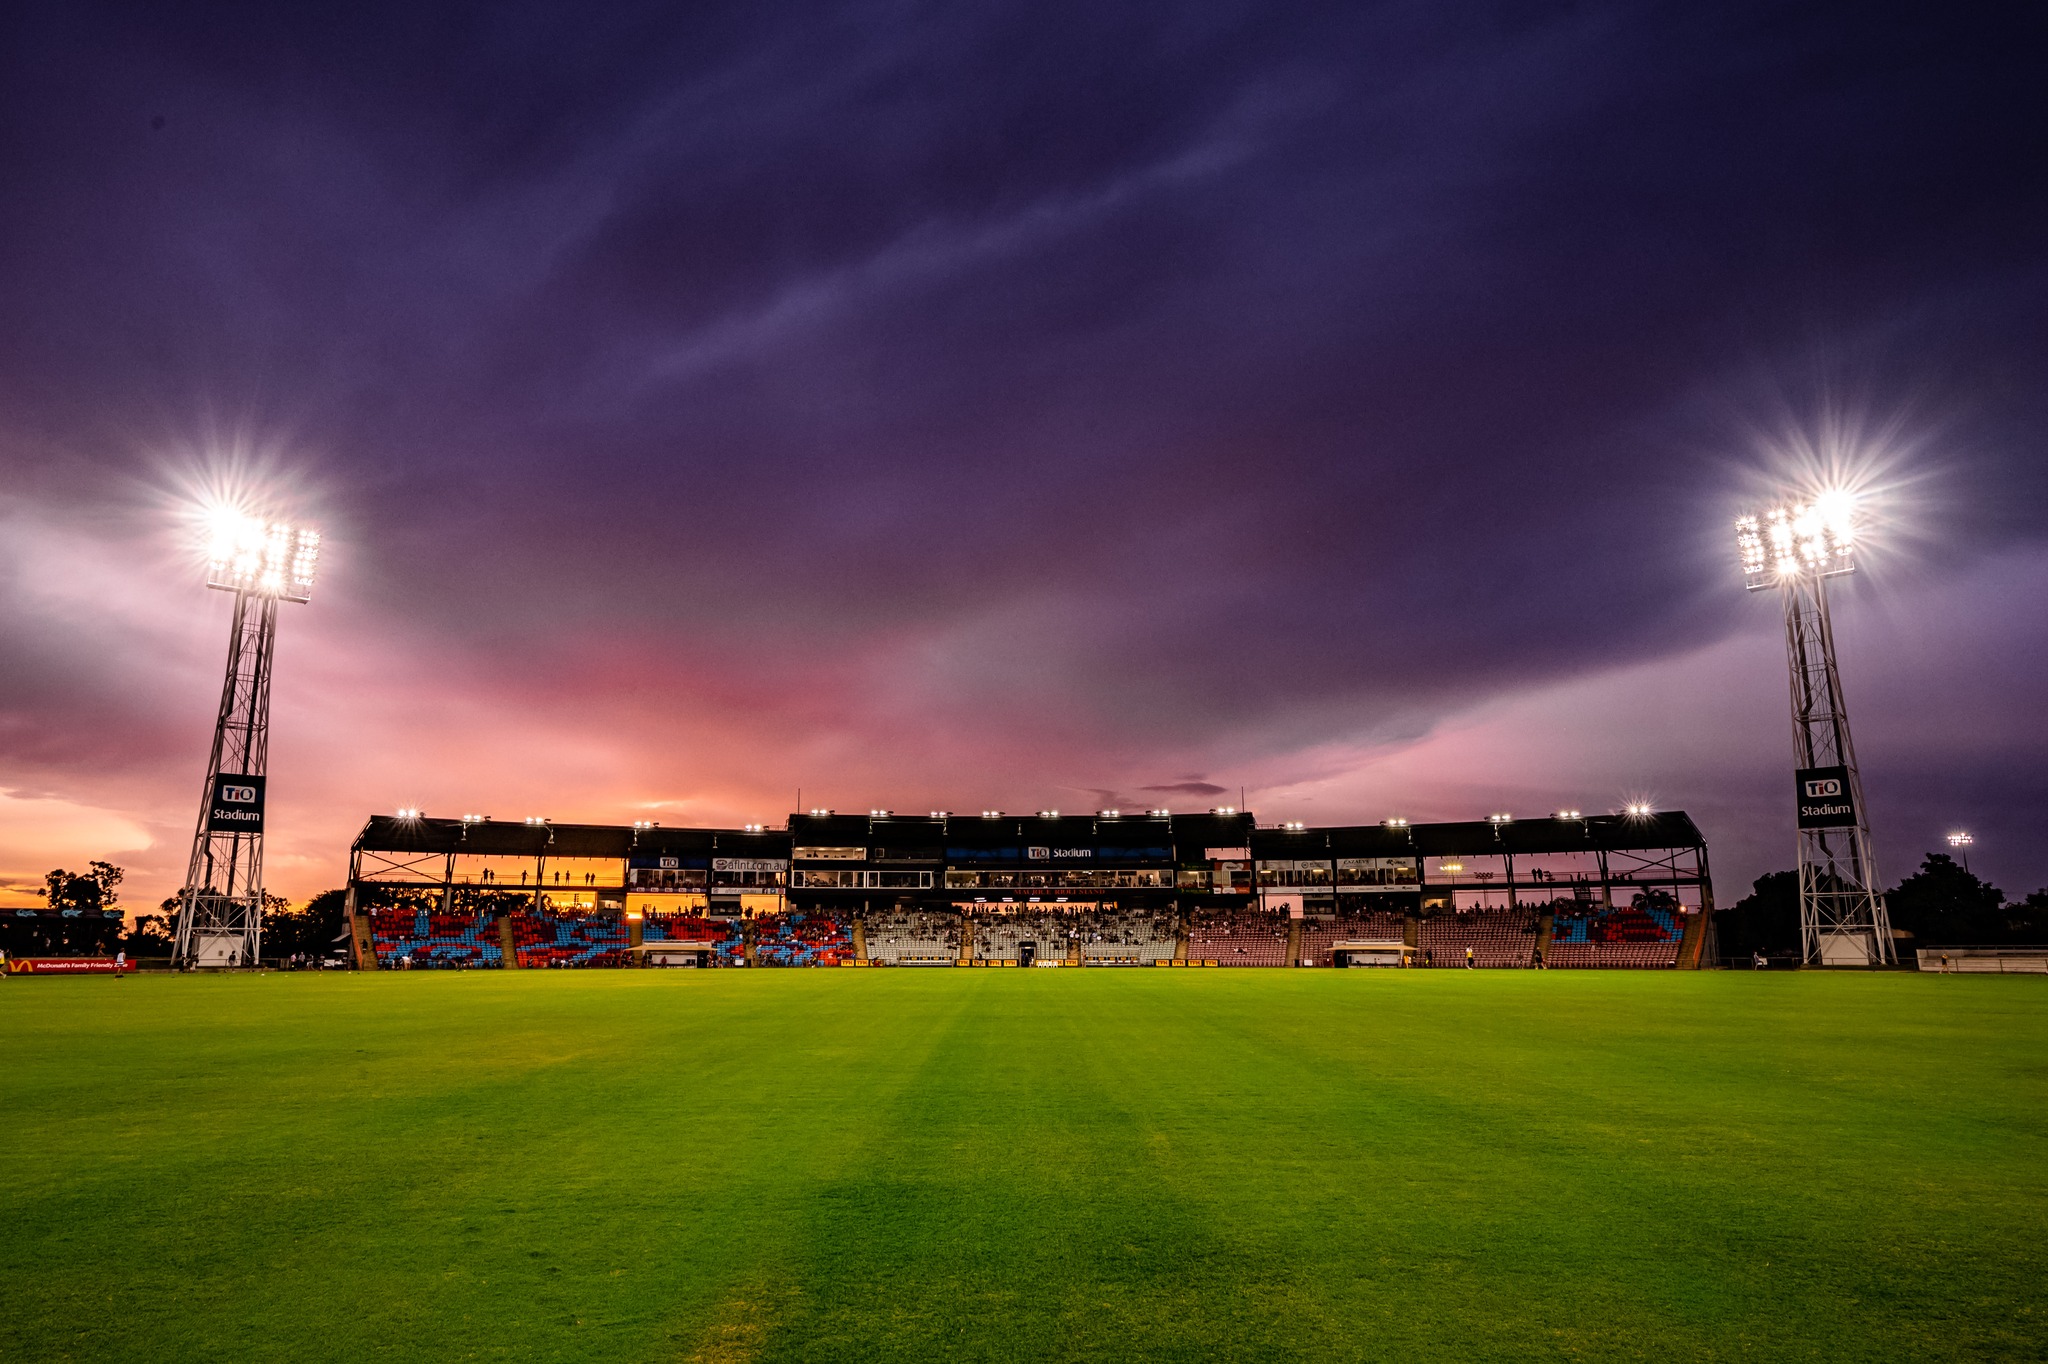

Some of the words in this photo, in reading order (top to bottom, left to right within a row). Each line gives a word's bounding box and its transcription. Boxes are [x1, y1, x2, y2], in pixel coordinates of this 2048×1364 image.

[213, 808, 260, 822] Stadium
[1801, 803, 1851, 817] Stadium
[1053, 847, 1092, 858] Stadium
[728, 860, 786, 871] aflnt.com.au
